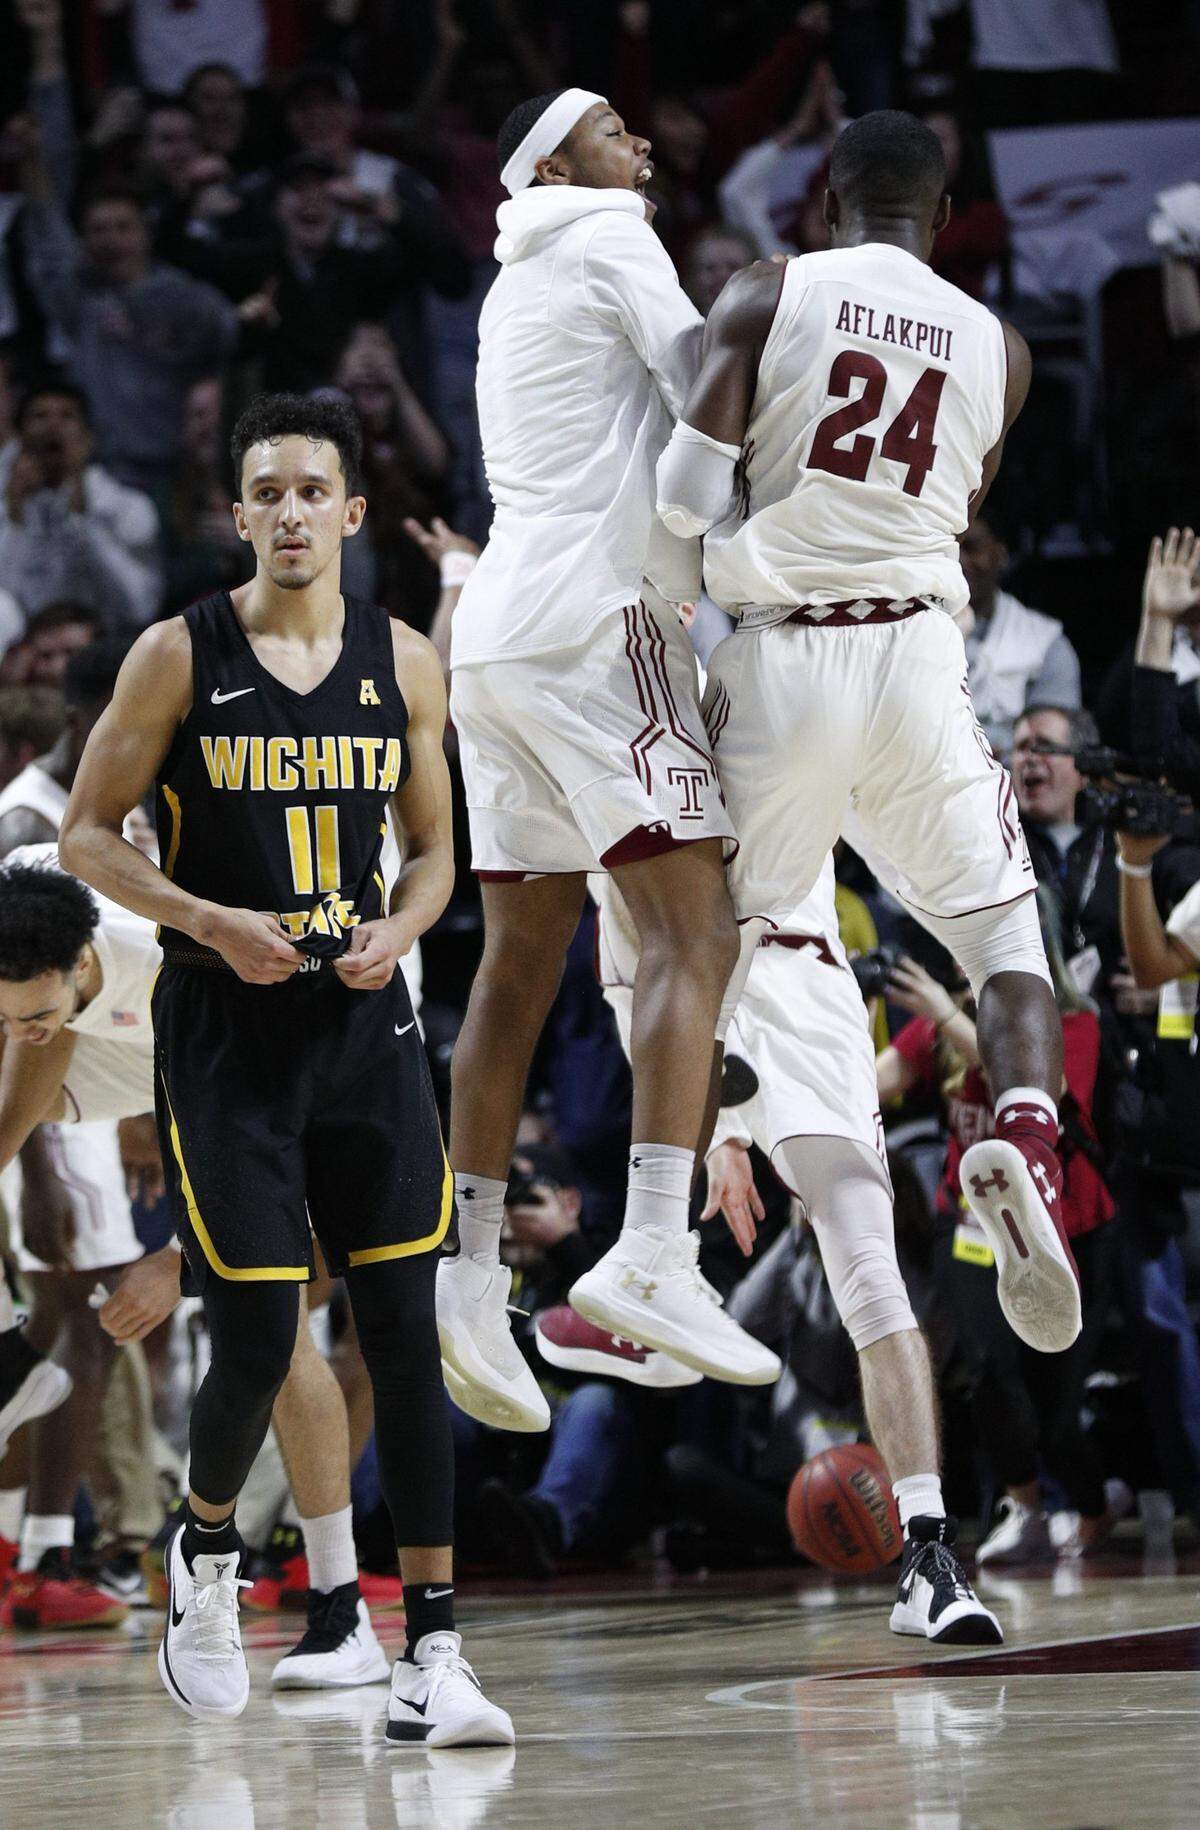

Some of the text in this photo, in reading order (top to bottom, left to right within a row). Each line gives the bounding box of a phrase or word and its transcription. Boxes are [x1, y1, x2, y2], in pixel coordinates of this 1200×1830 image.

[835, 300, 953, 361] AFLAKPUI
[806, 350, 948, 498] 24
[200, 736, 401, 792] WICHITA
[667, 767, 709, 820] T
[285, 805, 341, 895] 11
[850, 1467, 894, 1548] Wilson
